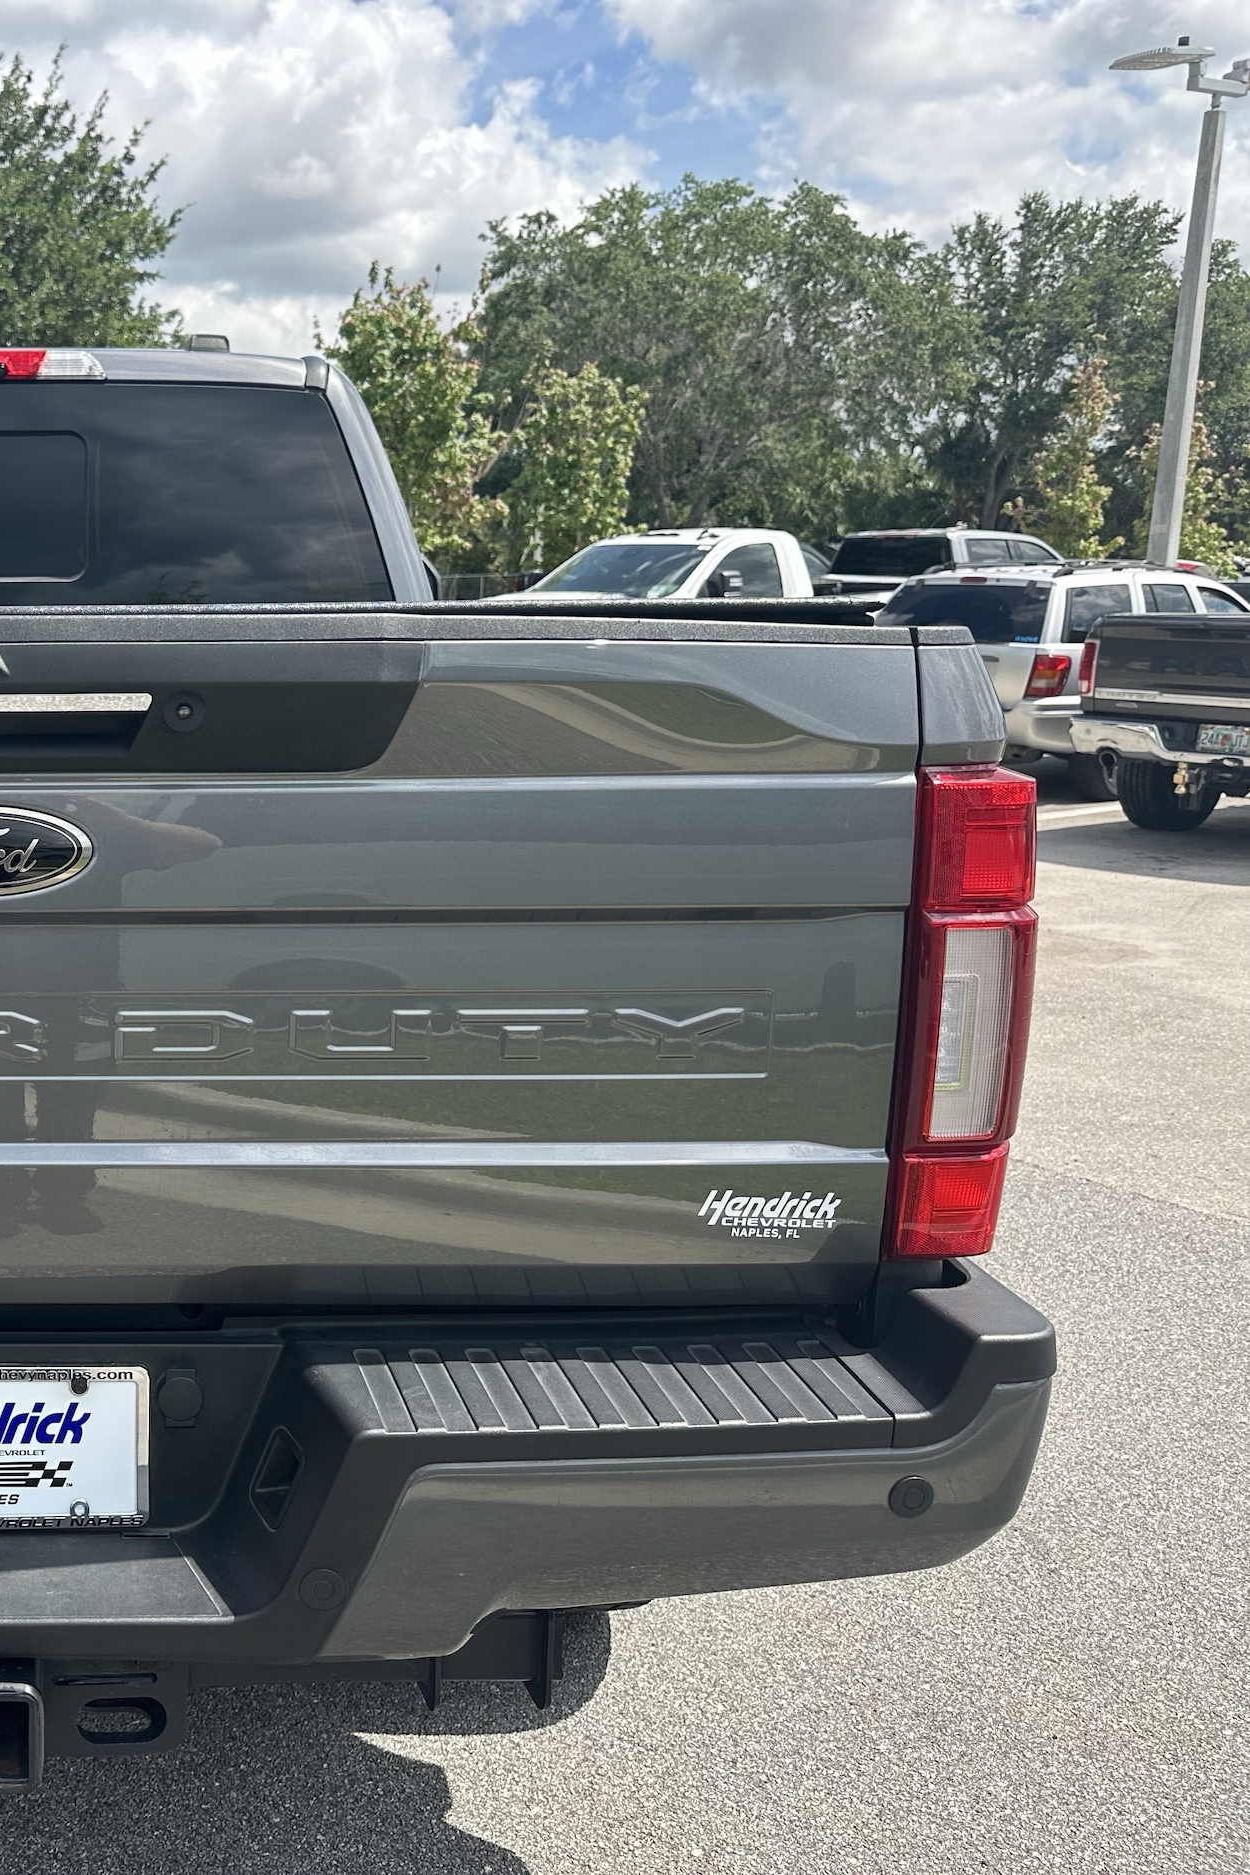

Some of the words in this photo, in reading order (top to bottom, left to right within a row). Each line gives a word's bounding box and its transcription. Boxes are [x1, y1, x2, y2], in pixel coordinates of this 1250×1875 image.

[114, 1007, 746, 1061] DUTY
[697, 1189, 842, 1225] Hendrick
[721, 1217, 836, 1228] CHEVROLET
[731, 1228, 782, 1239] NAPLES,
[786, 1229, 800, 1238] FL
[70, 1514, 144, 1527] NAPLES
